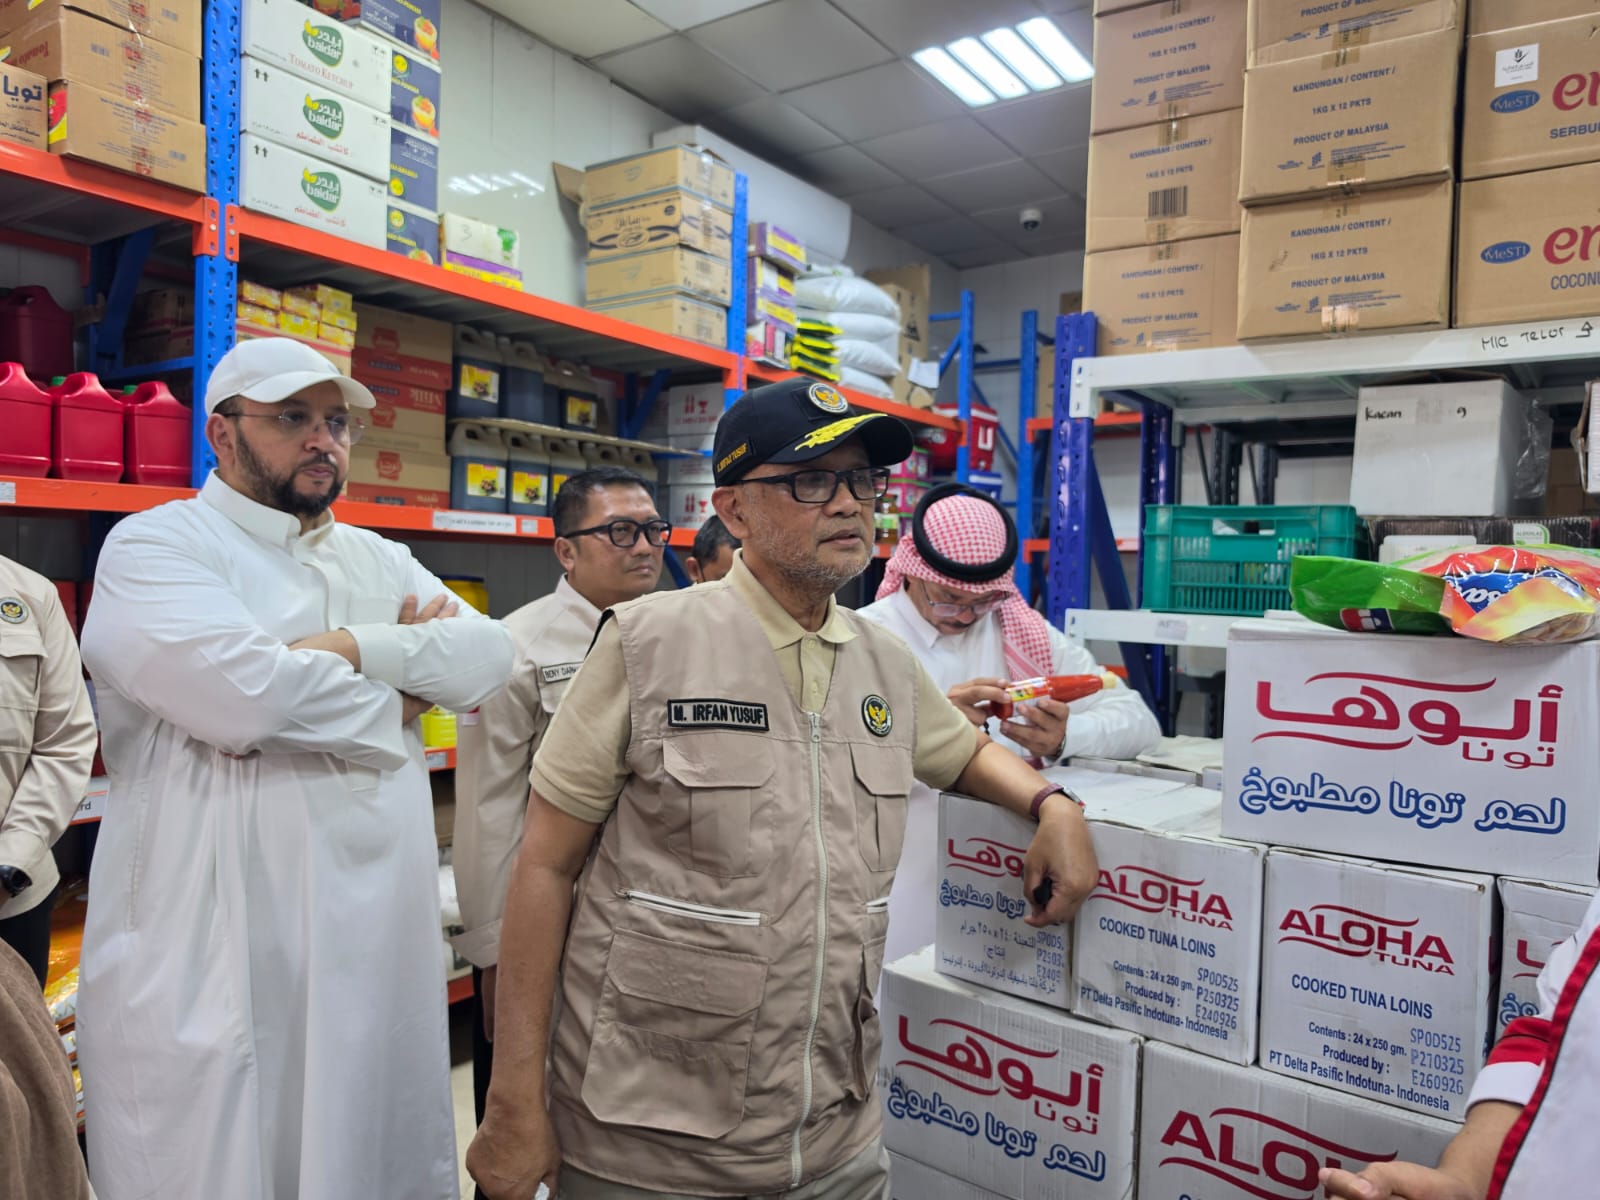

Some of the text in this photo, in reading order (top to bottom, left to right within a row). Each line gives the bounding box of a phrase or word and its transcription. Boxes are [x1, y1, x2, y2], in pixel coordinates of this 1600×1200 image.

[1301, 2, 1340, 17] PRODUCT
[1292, 77, 1343, 93] KANDUNGAN
[1350, 68, 1390, 82] CONTENT
[1312, 98, 1371, 115] 1KG X 12 PKTS
[1294, 123, 1389, 145] PRODUCT OF MALAYSIA
[1549, 122, 1600, 139] SERBU
[1290, 223, 1340, 238] KANDUNGAN
[1347, 219, 1386, 231] CONTENT
[1311, 252, 1326, 261] 1KG
[1336, 249, 1345, 257] 12
[1347, 247, 1368, 256] PKTS
[1291, 272, 1385, 289] PRODUCT OF MALAYSIA
[673, 704, 763, 724] M. IRFAN YUSUF
[1462, 742, 1555, 769] تونا
[1240, 767, 1566, 835] لحم تونا مطبوخ
[940, 879, 1026, 919] تونا مطبوخ
[1097, 869, 1233, 921] ALOHA
[1167, 908, 1233, 932] TUNA
[1100, 917, 1216, 958] COOKED TUNA LOINS
[1279, 909, 1455, 965] ALOHA
[1037, 948, 1064, 967] P2503
[1374, 951, 1455, 976] TUNA
[1113, 960, 1144, 978] Contents
[1150, 970, 1159, 982] 24
[1167, 974, 1179, 987] 250
[1180, 981, 1194, 992] gm.
[1125, 981, 1163, 1001] Produced
[1165, 991, 1176, 1008] by
[1196, 986, 1239, 1012] P250325
[1291, 974, 1433, 1020] COOKED TUNA LOINS
[1081, 986, 1091, 999] PT
[1092, 989, 1113, 1007] Delta
[1115, 996, 1142, 1016] Pasific
[1185, 1016, 1228, 1040] Indonesia
[1195, 1004, 1237, 1030] E240926
[1309, 1021, 1346, 1041] Contents
[1353, 1032, 1364, 1045] 24
[1365, 1038, 1371, 1047] x
[1373, 1038, 1389, 1051] 250
[1390, 1044, 1407, 1057] gm.
[1323, 1045, 1369, 1068] Produced
[1371, 1056, 1384, 1074] by
[1270, 1051, 1450, 1112] PT Delta Pasific Indotuna- Indonesia
[1412, 1069, 1464, 1096] E260926
[887, 1079, 1106, 1182] لحم تونا مطبوخ
[1034, 1099, 1099, 1136] تونا
